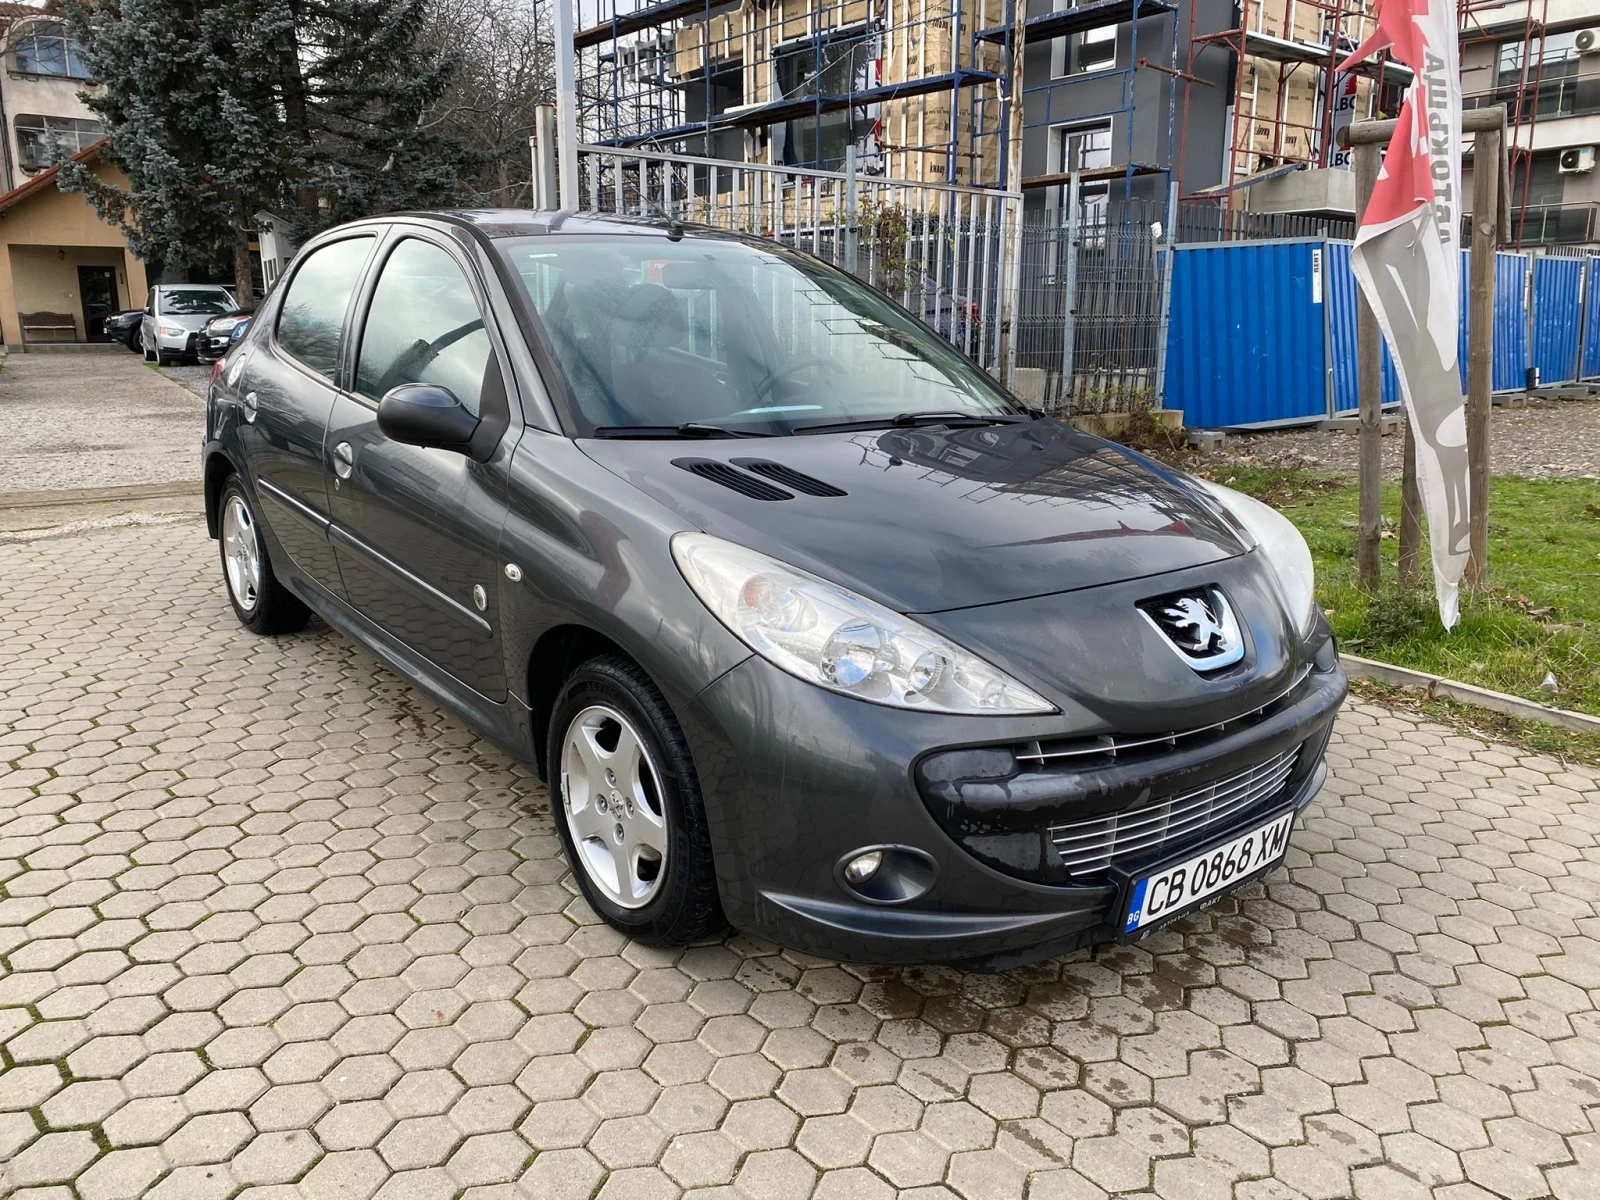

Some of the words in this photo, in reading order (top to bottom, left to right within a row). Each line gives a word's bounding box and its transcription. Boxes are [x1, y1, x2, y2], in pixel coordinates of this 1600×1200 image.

[1148, 868, 1186, 916] CB
[1190, 836, 1254, 896] 0868
[1254, 818, 1289, 866] XM
[1127, 909, 1140, 925] BG
